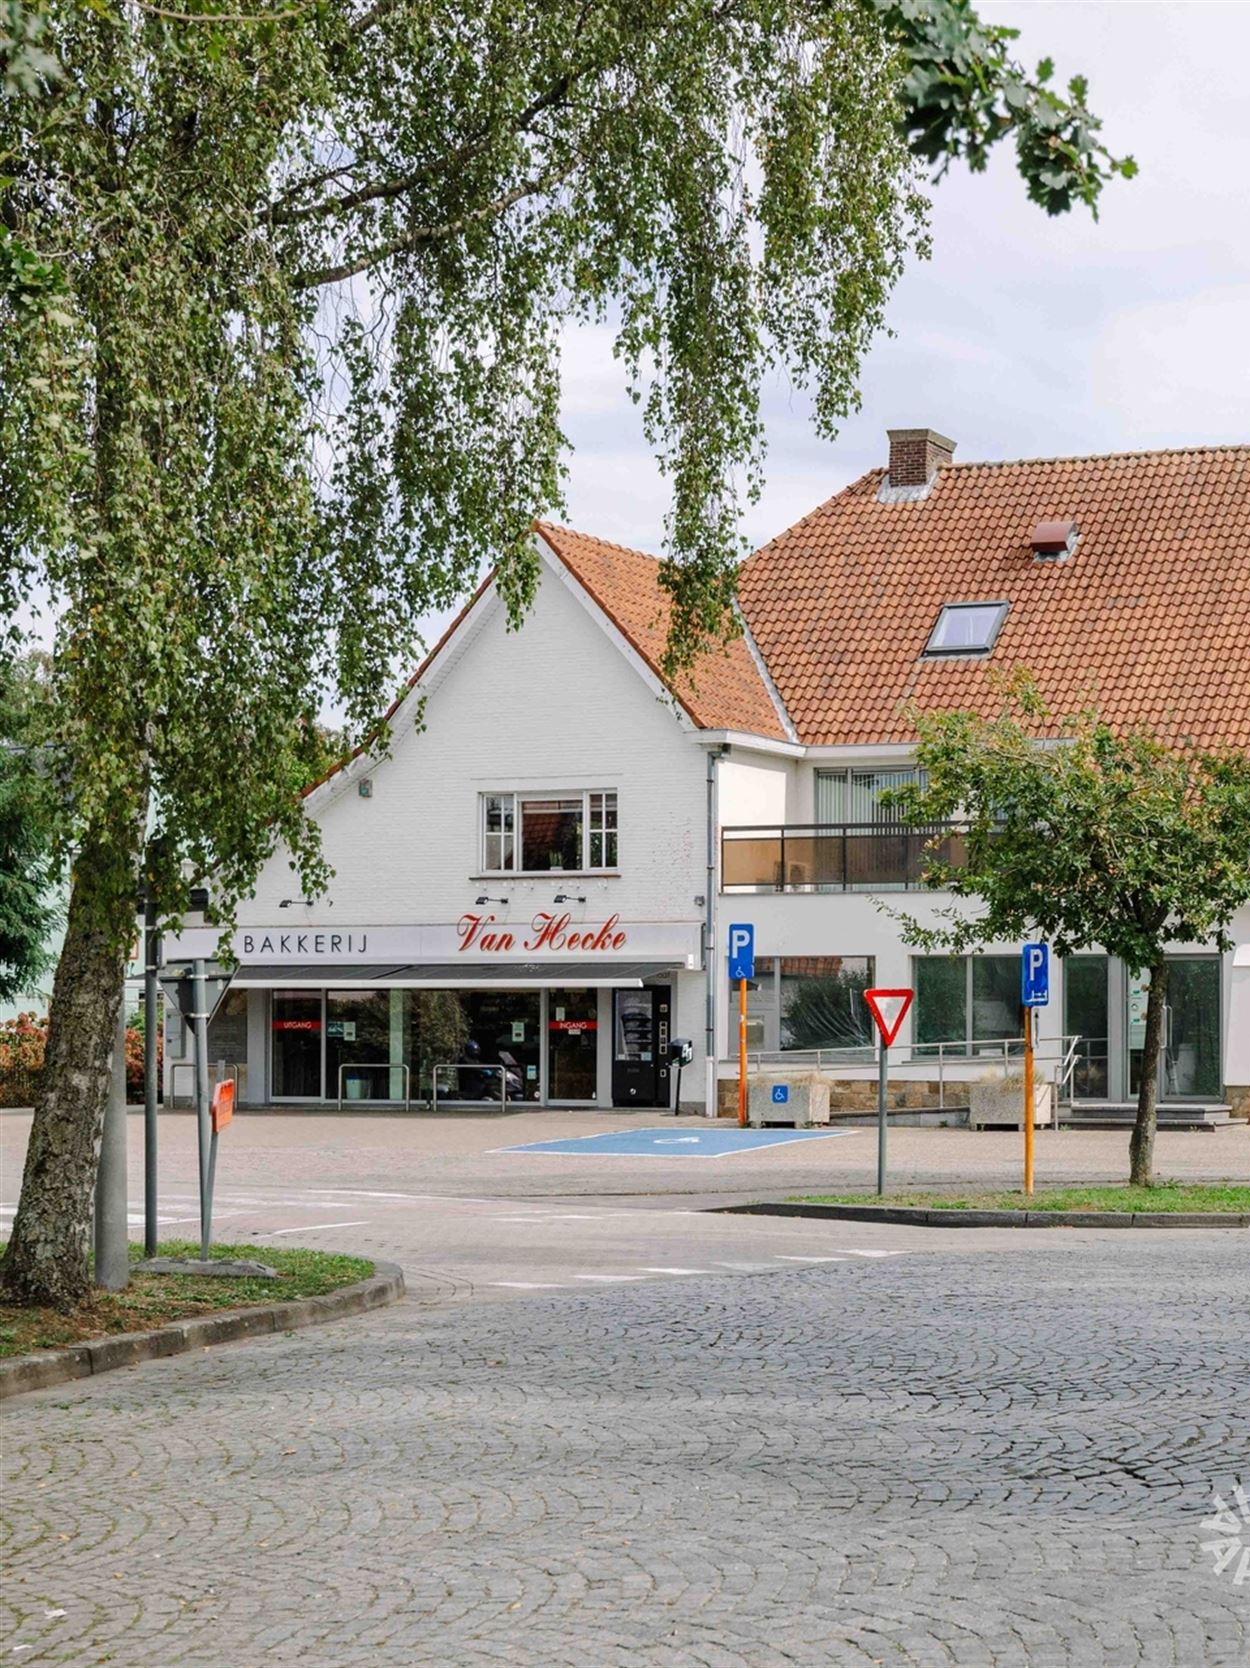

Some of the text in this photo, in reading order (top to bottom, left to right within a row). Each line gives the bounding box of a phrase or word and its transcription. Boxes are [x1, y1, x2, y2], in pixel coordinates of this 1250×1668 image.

[243, 934, 368, 954] BAKKERIJ
[457, 912, 627, 951] Van Hecke
[731, 929, 750, 959] P
[1030, 949, 1044, 981] P
[559, 1021, 588, 1030] INGANG
